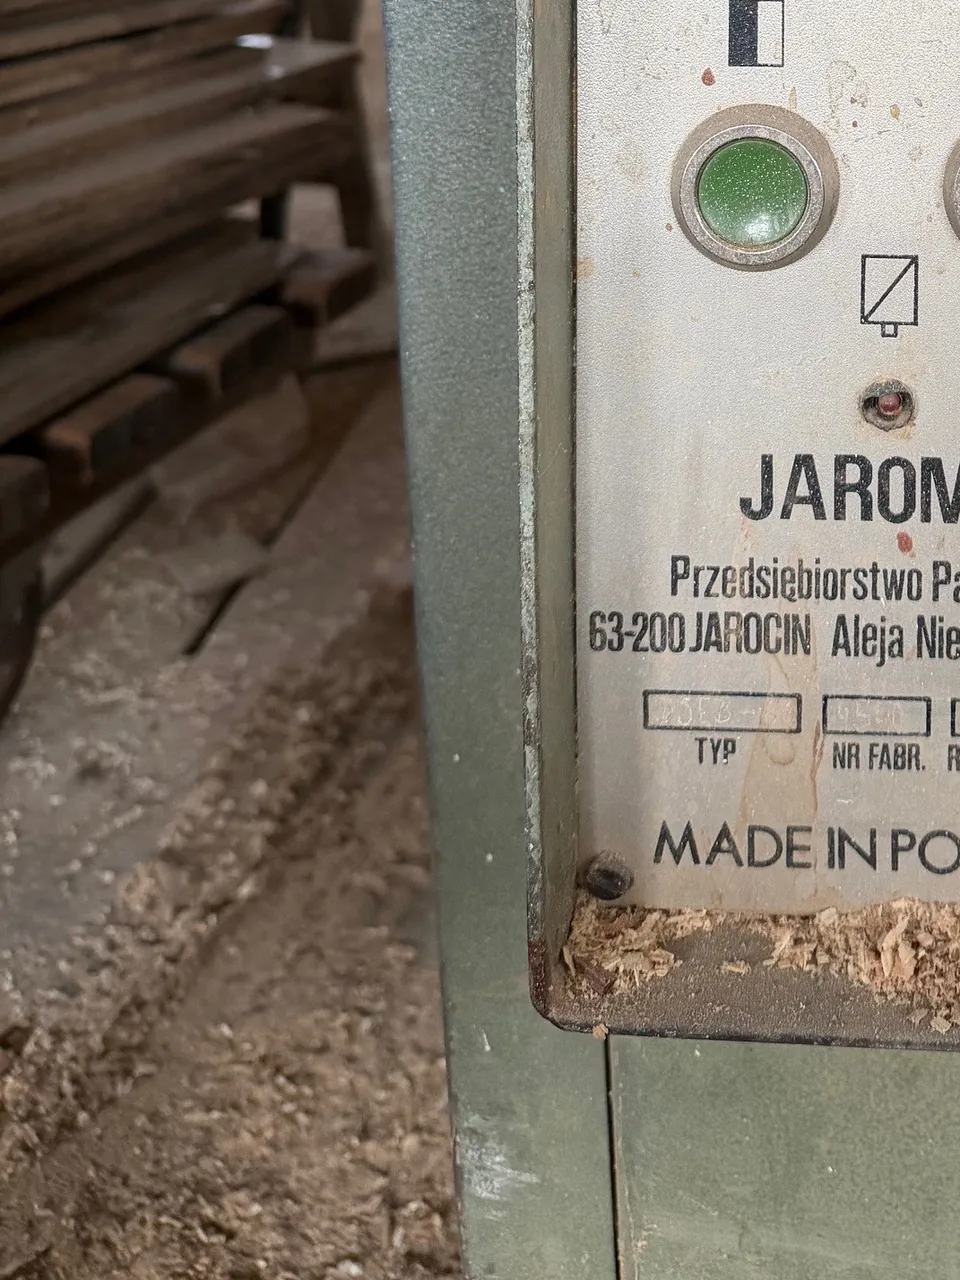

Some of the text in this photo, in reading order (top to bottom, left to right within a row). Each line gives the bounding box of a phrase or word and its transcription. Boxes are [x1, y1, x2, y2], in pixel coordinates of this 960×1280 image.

[671, 554, 922, 603] Przedsiębiorstwo
[589, 611, 685, 653] 63-200
[688, 612, 812, 656] JAROCIN
[832, 614, 904, 668] Aleja
[695, 738, 737, 765] TYP
[833, 743, 926, 771] NR FABR.
[653, 821, 813, 869] MADE
[828, 827, 877, 871] IN
